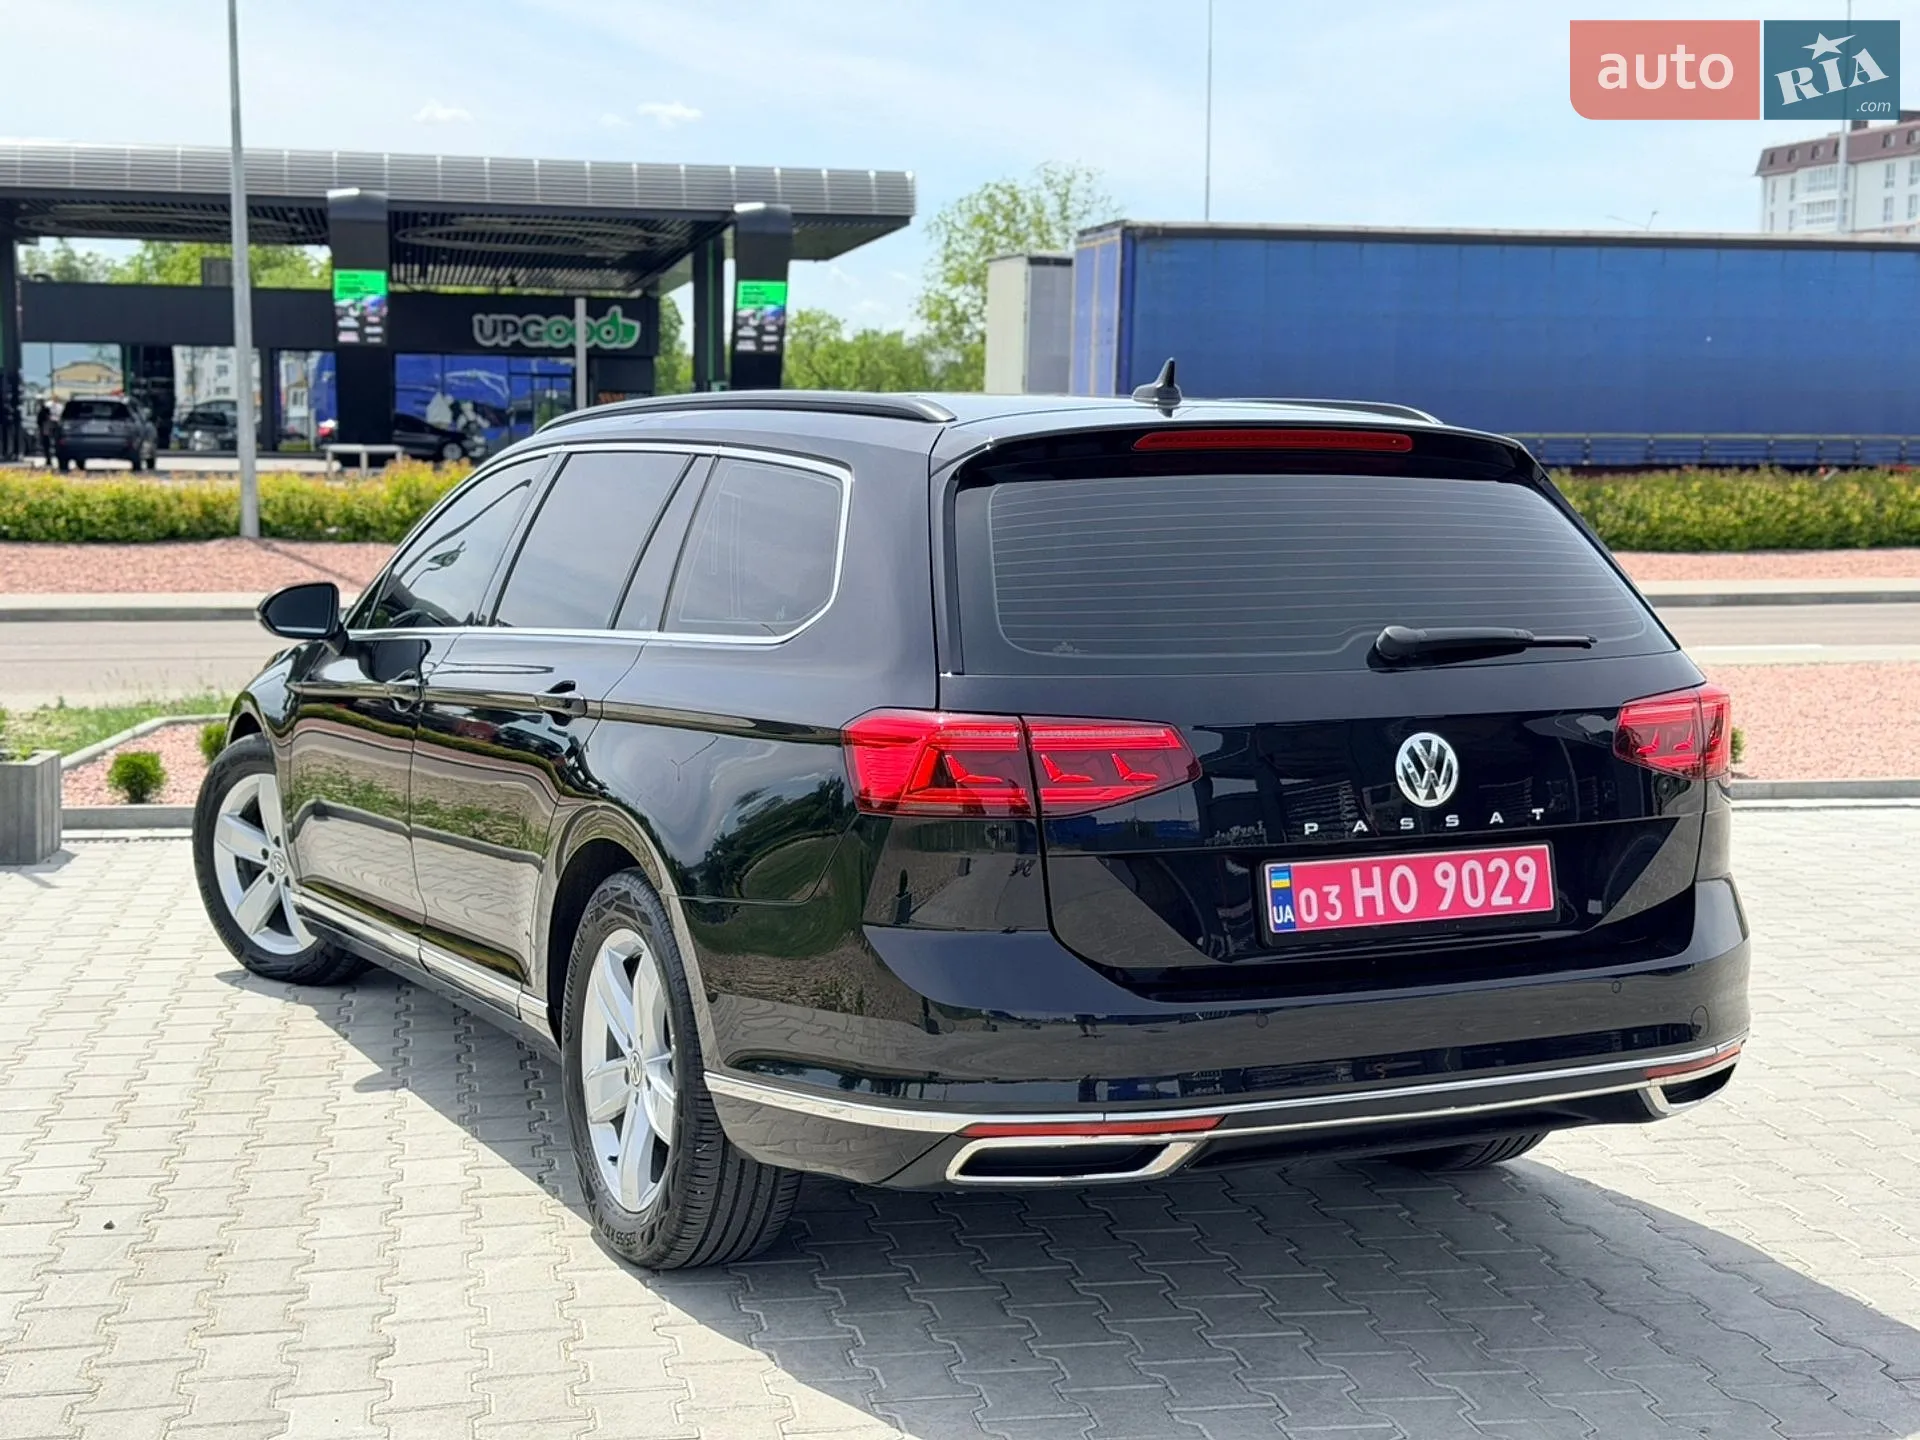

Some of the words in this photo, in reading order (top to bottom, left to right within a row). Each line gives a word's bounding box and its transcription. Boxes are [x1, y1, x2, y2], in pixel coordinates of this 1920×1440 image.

[1303, 808, 1545, 836] PASSAT
[1434, 855, 1537, 911] 9029
[1273, 905, 1294, 923] UA
